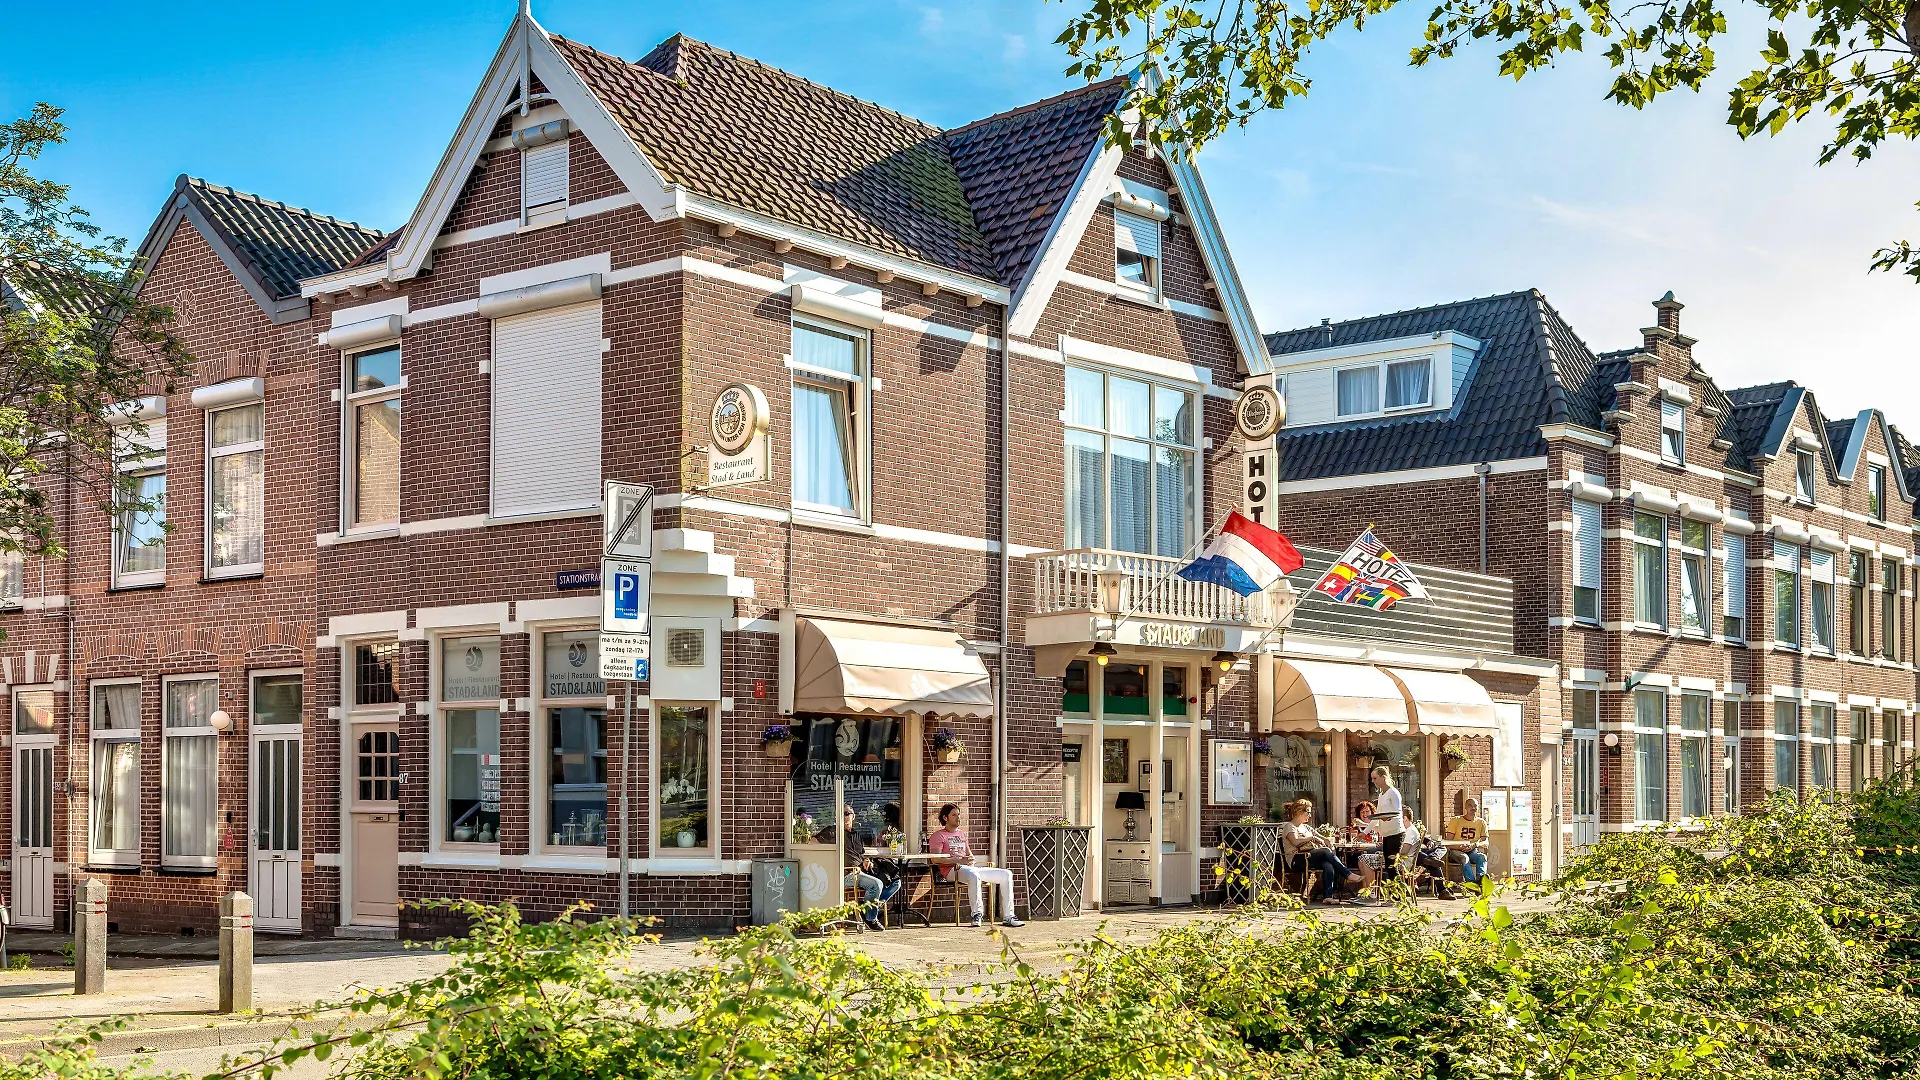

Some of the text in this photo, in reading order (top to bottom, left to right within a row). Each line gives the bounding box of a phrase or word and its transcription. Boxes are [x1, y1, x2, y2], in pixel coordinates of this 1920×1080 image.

[713, 457, 754, 470] Restaurant
[710, 467, 757, 484] Stad & Land
[620, 486, 640, 496] ZONE
[1247, 455, 1267, 523] HOT
[617, 563, 638, 573] ZONE
[1350, 551, 1413, 589] HOTEL
[559, 572, 601, 585] STATIONSTRA
[619, 576, 634, 601] P
[605, 646, 625, 654] zondag
[550, 671, 599, 681] Hotel Restaura
[448, 684, 500, 699] STAD&LAND
[550, 681, 606, 696] STAD&LAND
[810, 761, 882, 772] Hotel Restaurant
[398, 772, 409, 784] 87
[810, 773, 882, 792] STAD&LAND
[1460, 826, 1477, 841] 25
